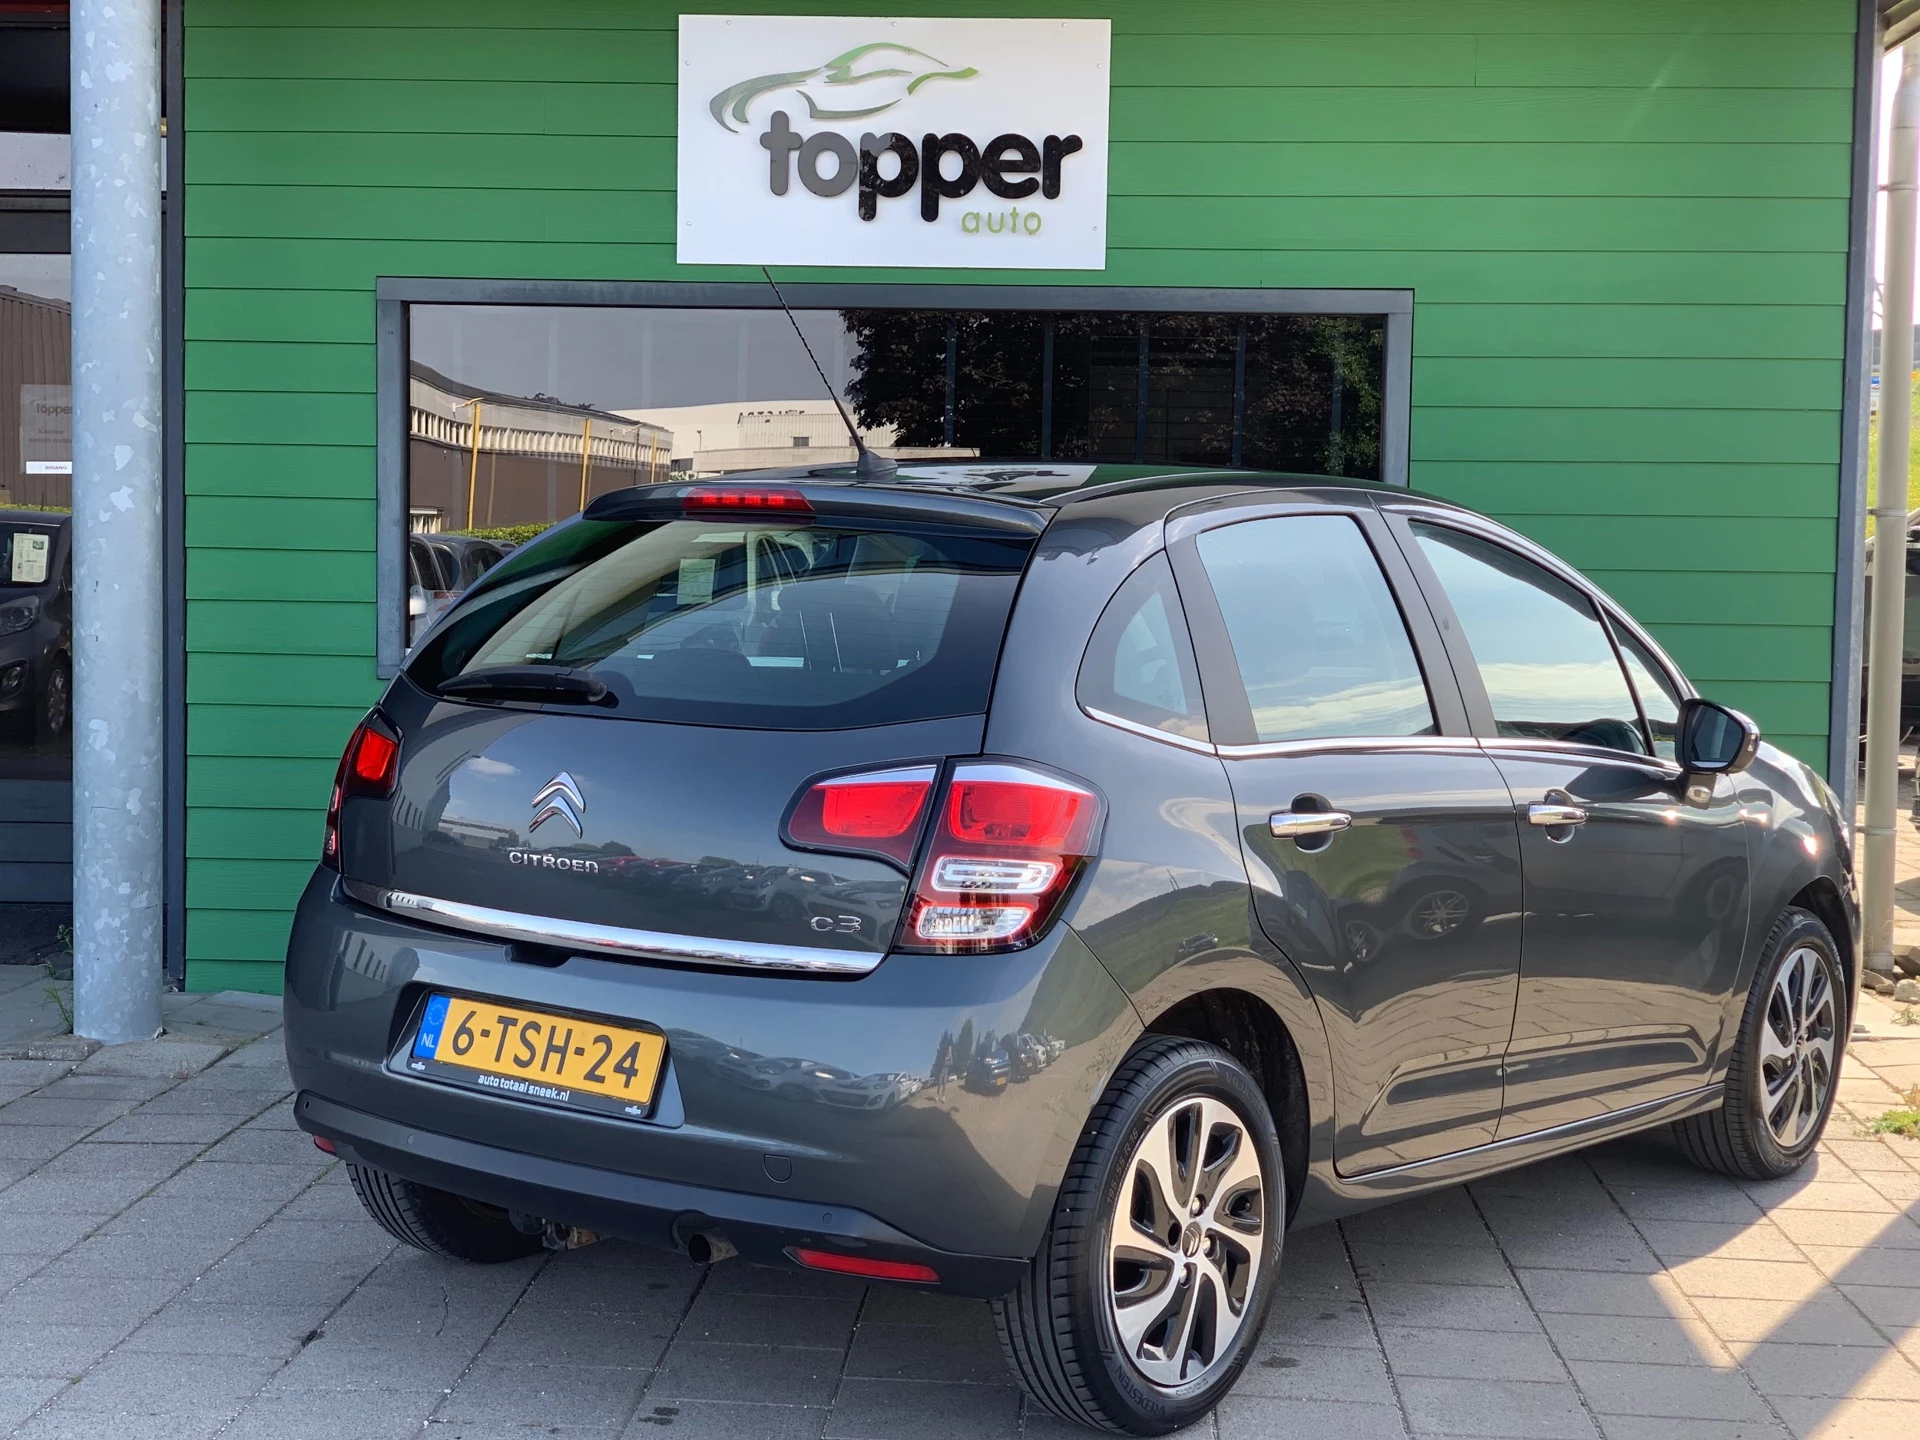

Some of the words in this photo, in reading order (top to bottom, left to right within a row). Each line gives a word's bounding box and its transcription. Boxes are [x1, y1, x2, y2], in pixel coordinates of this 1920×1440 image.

[759, 110, 1084, 222] topper
[961, 205, 1042, 236] auto
[508, 851, 599, 874] CITROEN
[809, 914, 862, 933] C3
[421, 1032, 435, 1049] NL
[452, 1010, 641, 1089] 6-TSH-24
[478, 1074, 499, 1087] auto
[500, 1077, 529, 1092] totaal
[528, 1084, 570, 1102] sneek.nl
[1107, 1156, 1126, 1204] 195/55
[1130, 1127, 1139, 1142] 16
[1115, 1365, 1166, 1417] VREDESTEIN
